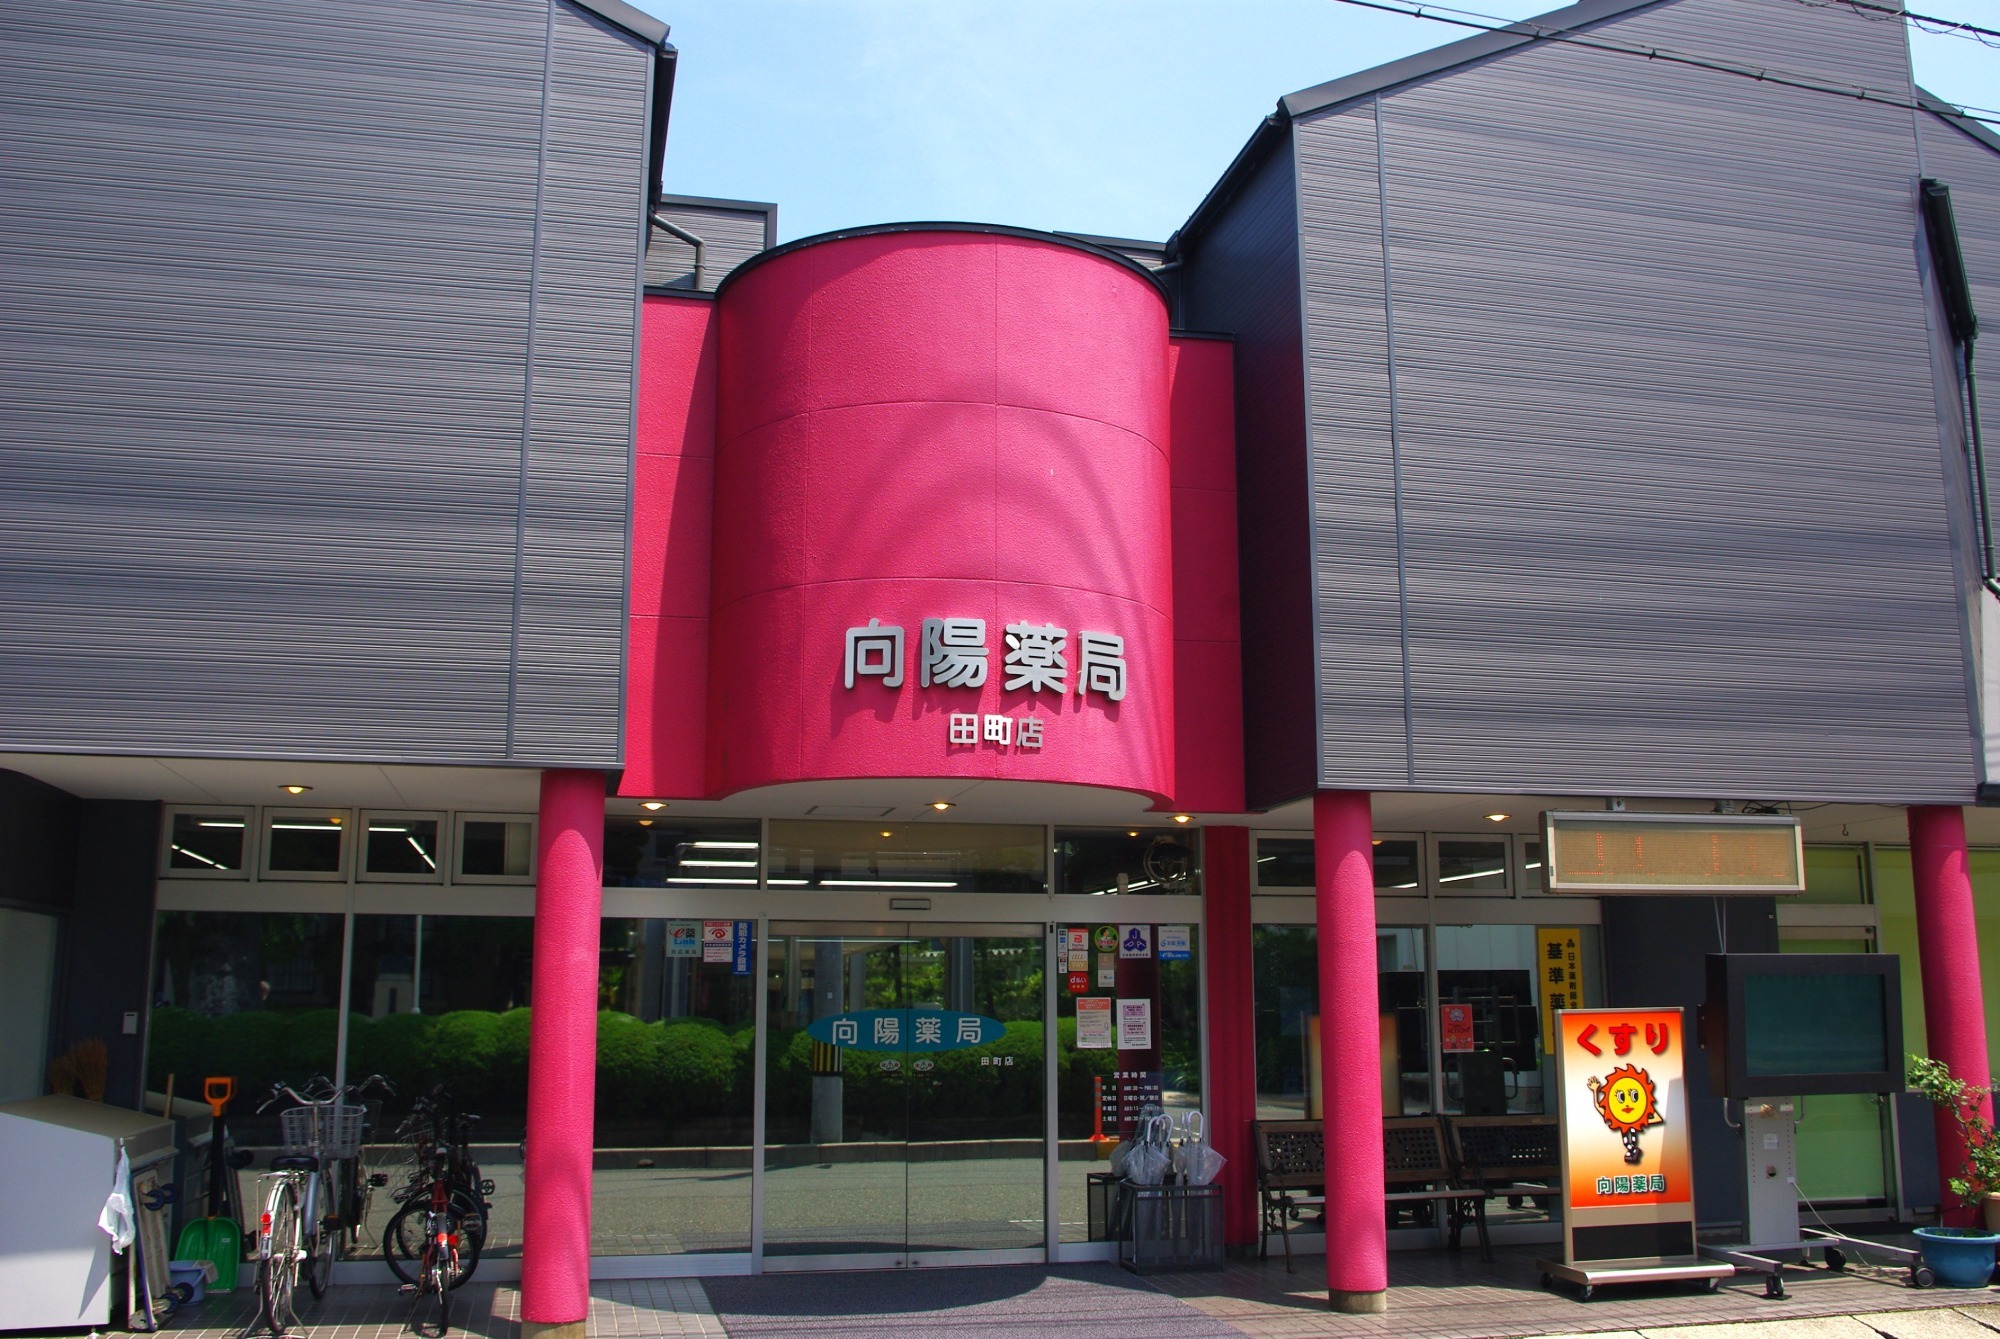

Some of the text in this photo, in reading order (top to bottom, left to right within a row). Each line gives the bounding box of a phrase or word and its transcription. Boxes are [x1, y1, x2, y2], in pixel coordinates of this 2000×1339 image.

[844, 618, 1127, 701] 向陽薬局
[949, 713, 1045, 748] 田町店
[737, 922, 748, 972] 防犯カメラ設置
[1547, 942, 1566, 1010] 基準薬
[832, 1017, 982, 1045] 向陽薬局
[1577, 1022, 1668, 1056] くすり
[981, 1056, 1014, 1067] 田町店
[1113, 1071, 1147, 1079] 営業時間
[1596, 1174, 1666, 1194] 向陽薬局
